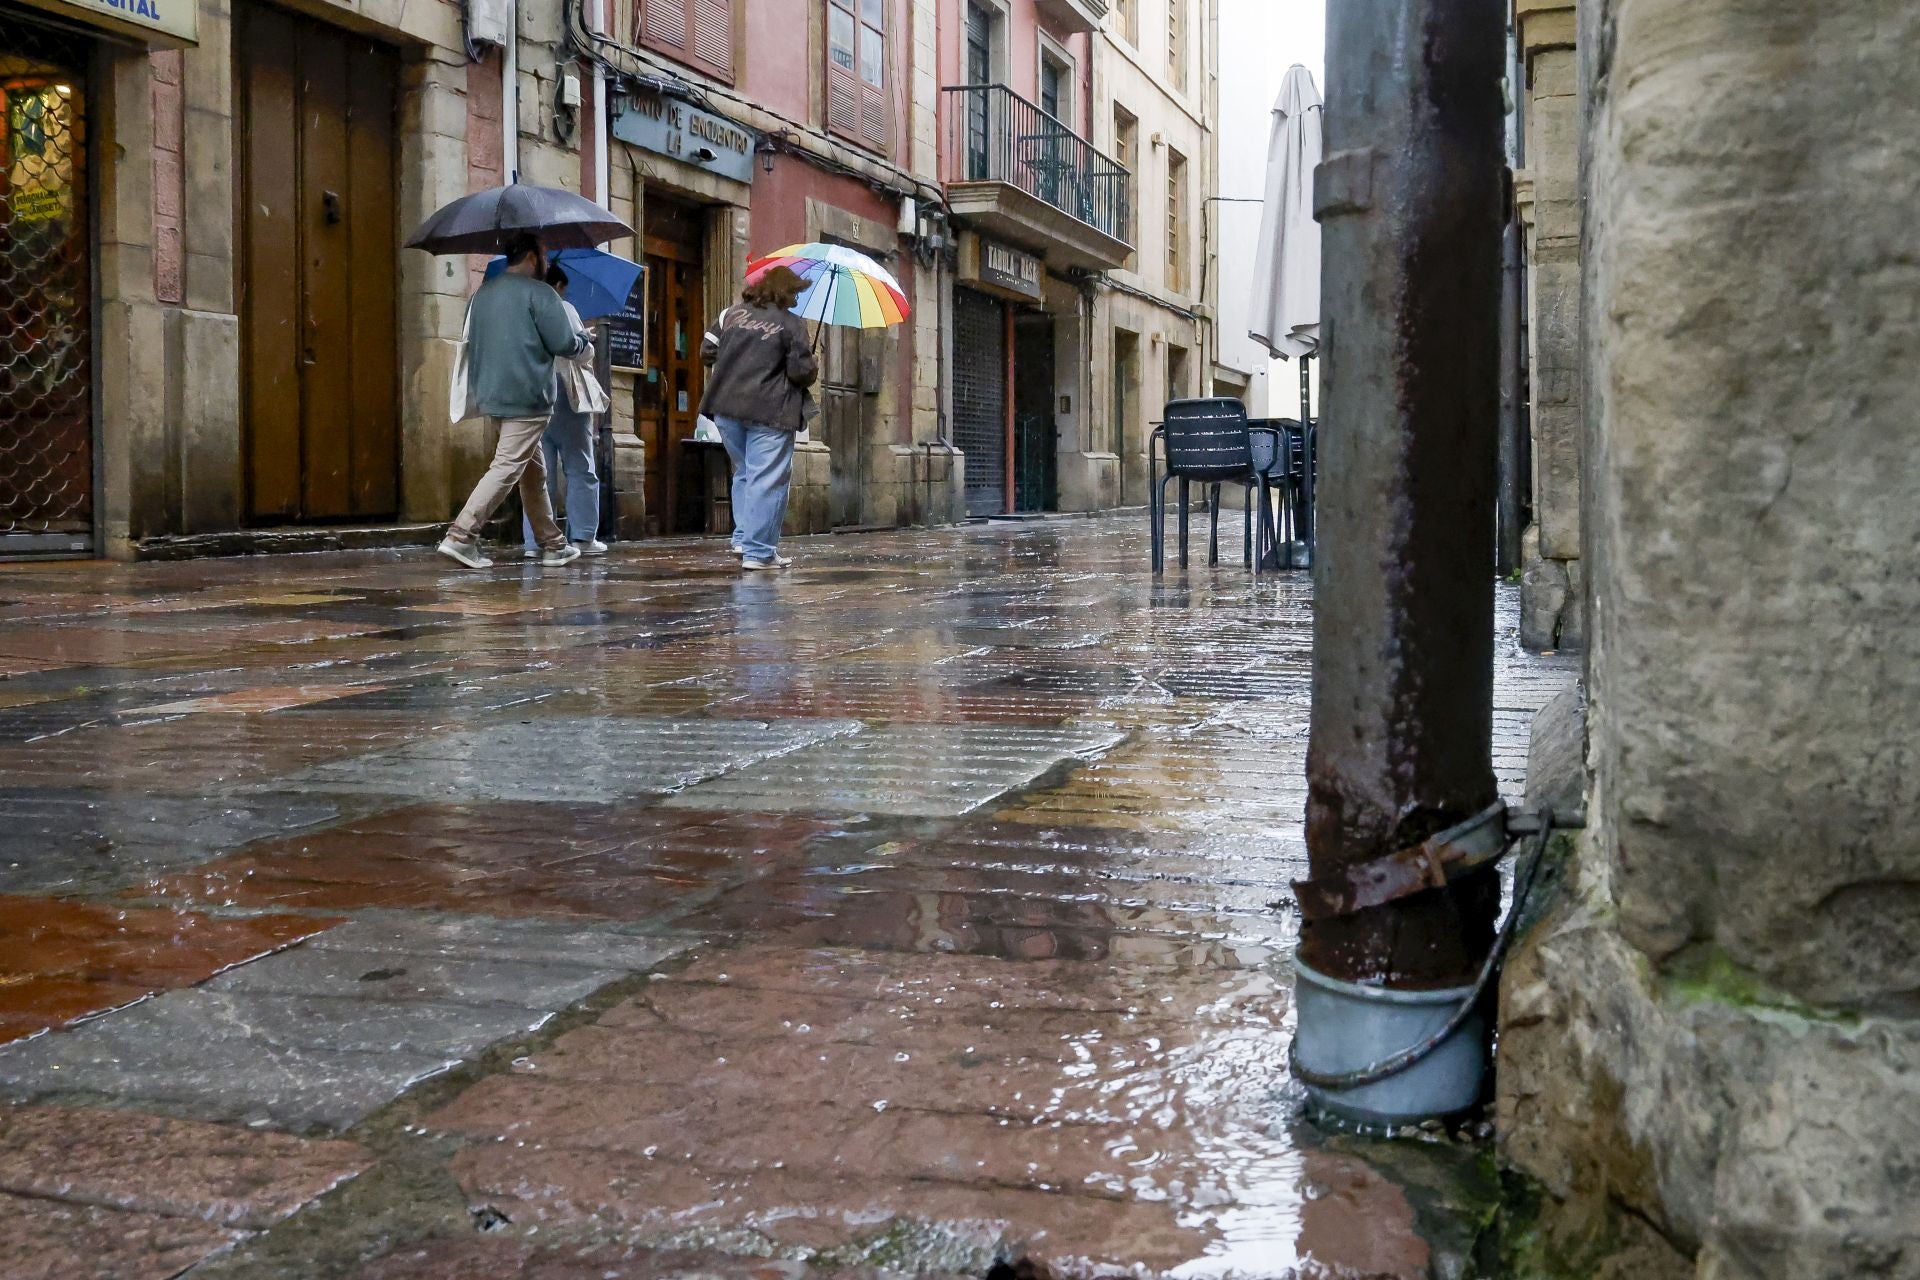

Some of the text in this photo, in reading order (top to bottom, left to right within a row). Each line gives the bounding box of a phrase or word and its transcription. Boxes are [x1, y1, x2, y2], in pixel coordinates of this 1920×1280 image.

[667, 130, 681, 155] LA
[668, 103, 681, 130] DE
[690, 113, 748, 155] ENCUENTRO
